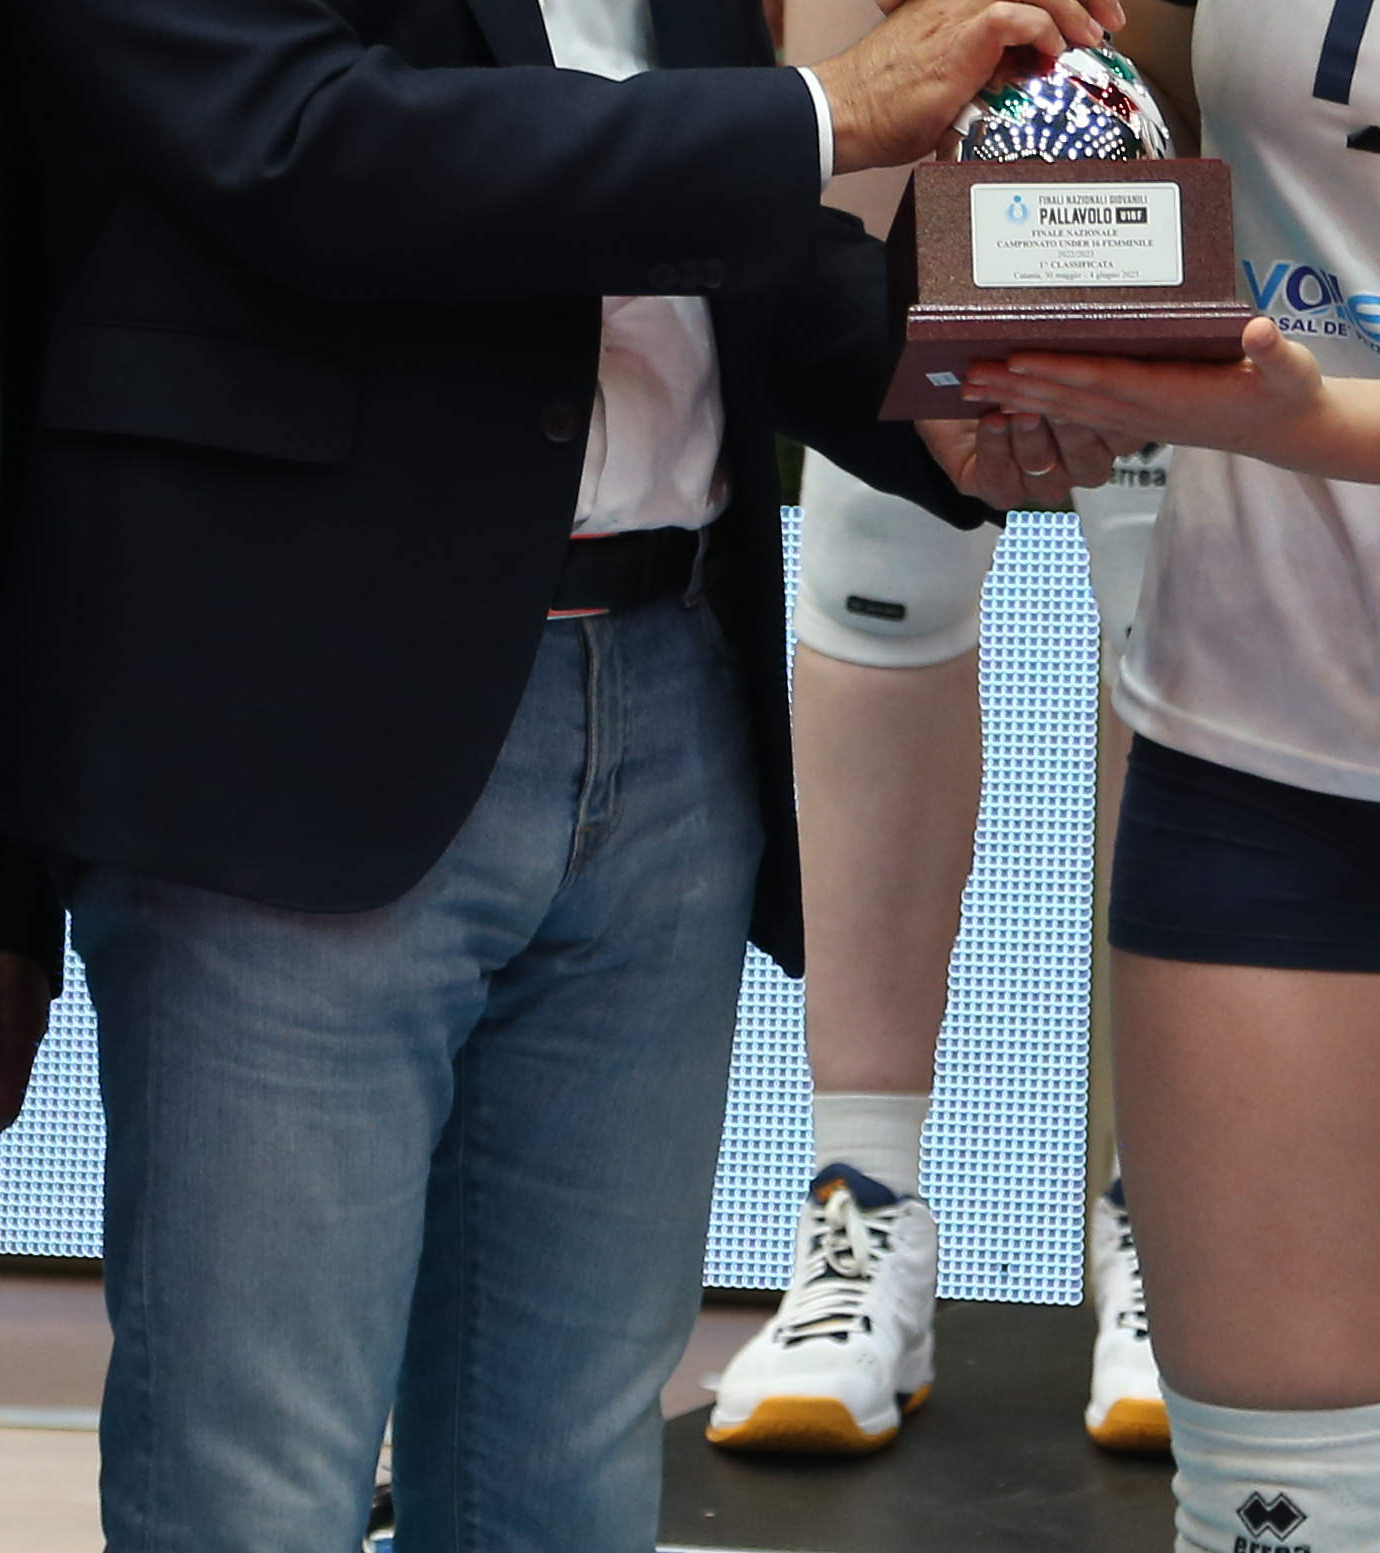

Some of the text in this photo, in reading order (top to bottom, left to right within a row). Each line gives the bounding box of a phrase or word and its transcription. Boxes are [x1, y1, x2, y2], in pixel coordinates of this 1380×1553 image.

[1039, 194, 1148, 205] FINALI NAZIONALI GIOVANILI
[1040, 207, 1112, 225] PALLAVOLO
[1066, 229, 1118, 237] NAZIONALE
[996, 239, 1057, 248] CAMPIONATO
[1058, 239, 1089, 247] UNDER
[1102, 239, 1153, 247] FEMMINILE
[1050, 260, 1114, 269] CLASSIFICATA
